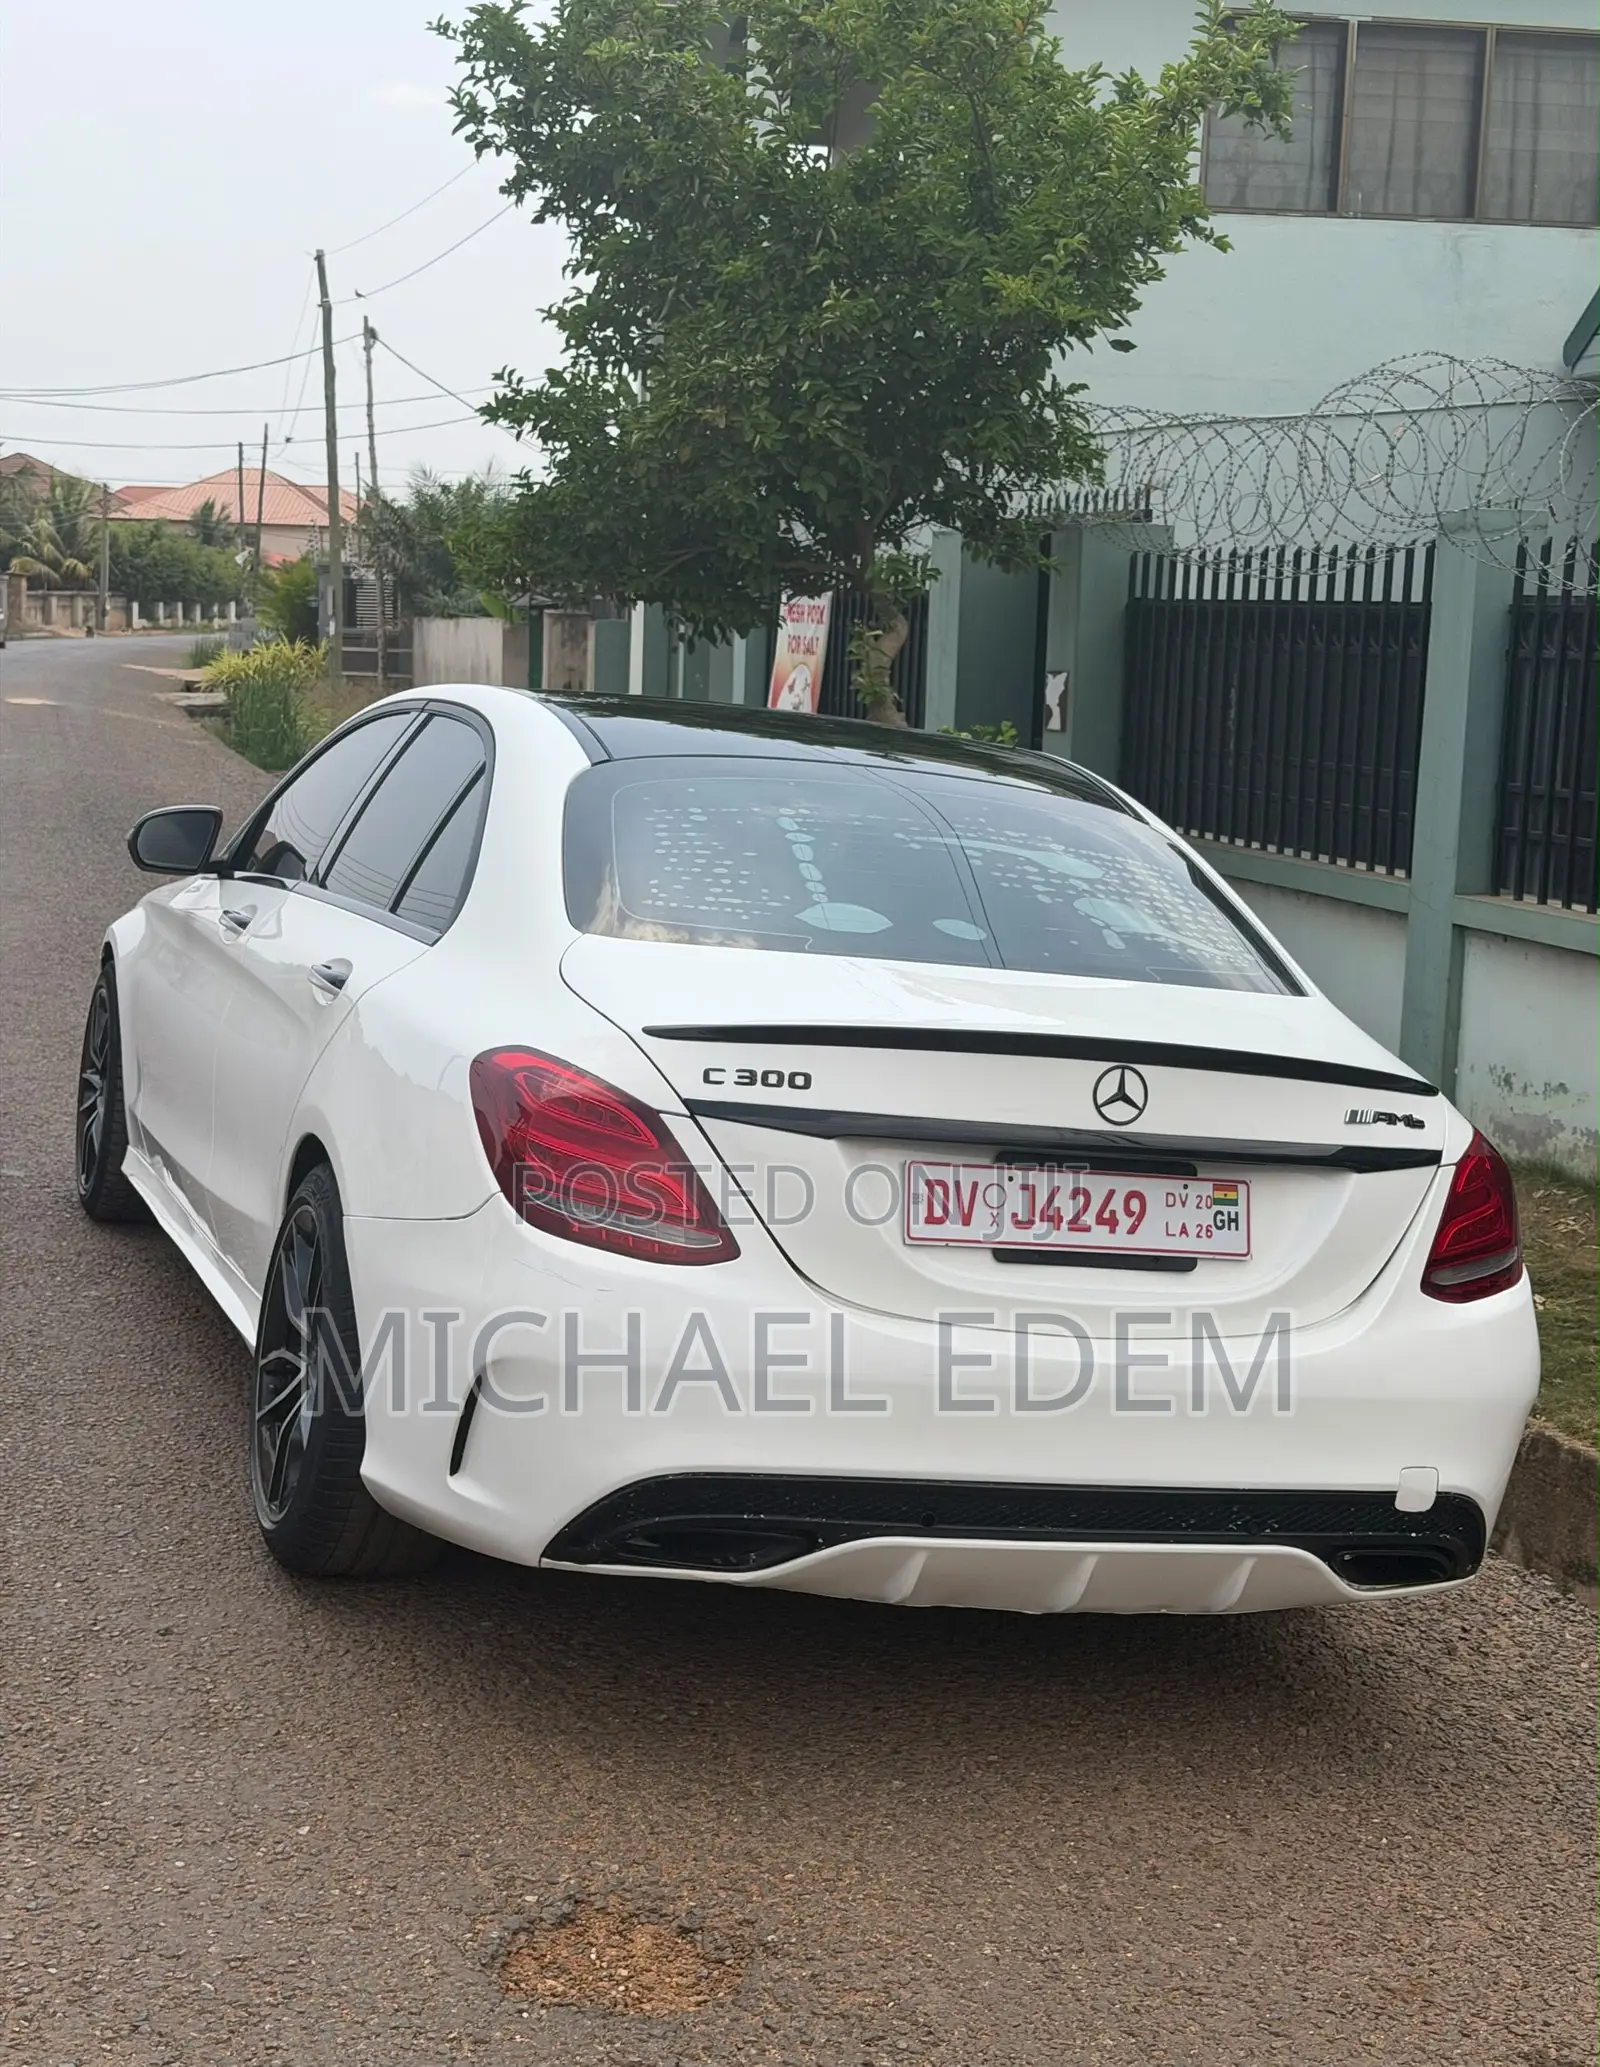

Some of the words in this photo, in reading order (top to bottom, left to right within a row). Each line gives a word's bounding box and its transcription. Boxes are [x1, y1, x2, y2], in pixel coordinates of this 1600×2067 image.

[703, 1067, 726, 1085] C
[733, 1069, 812, 1090] 300
[924, 1179, 979, 1227] DV
[1011, 1184, 1147, 1236] J4249
[1165, 1192, 1189, 1208] DV
[1195, 1194, 1213, 1210] 20
[1165, 1221, 1190, 1238] LA
[1195, 1223, 1213, 1239] 26
[1213, 1209, 1240, 1232] GH
